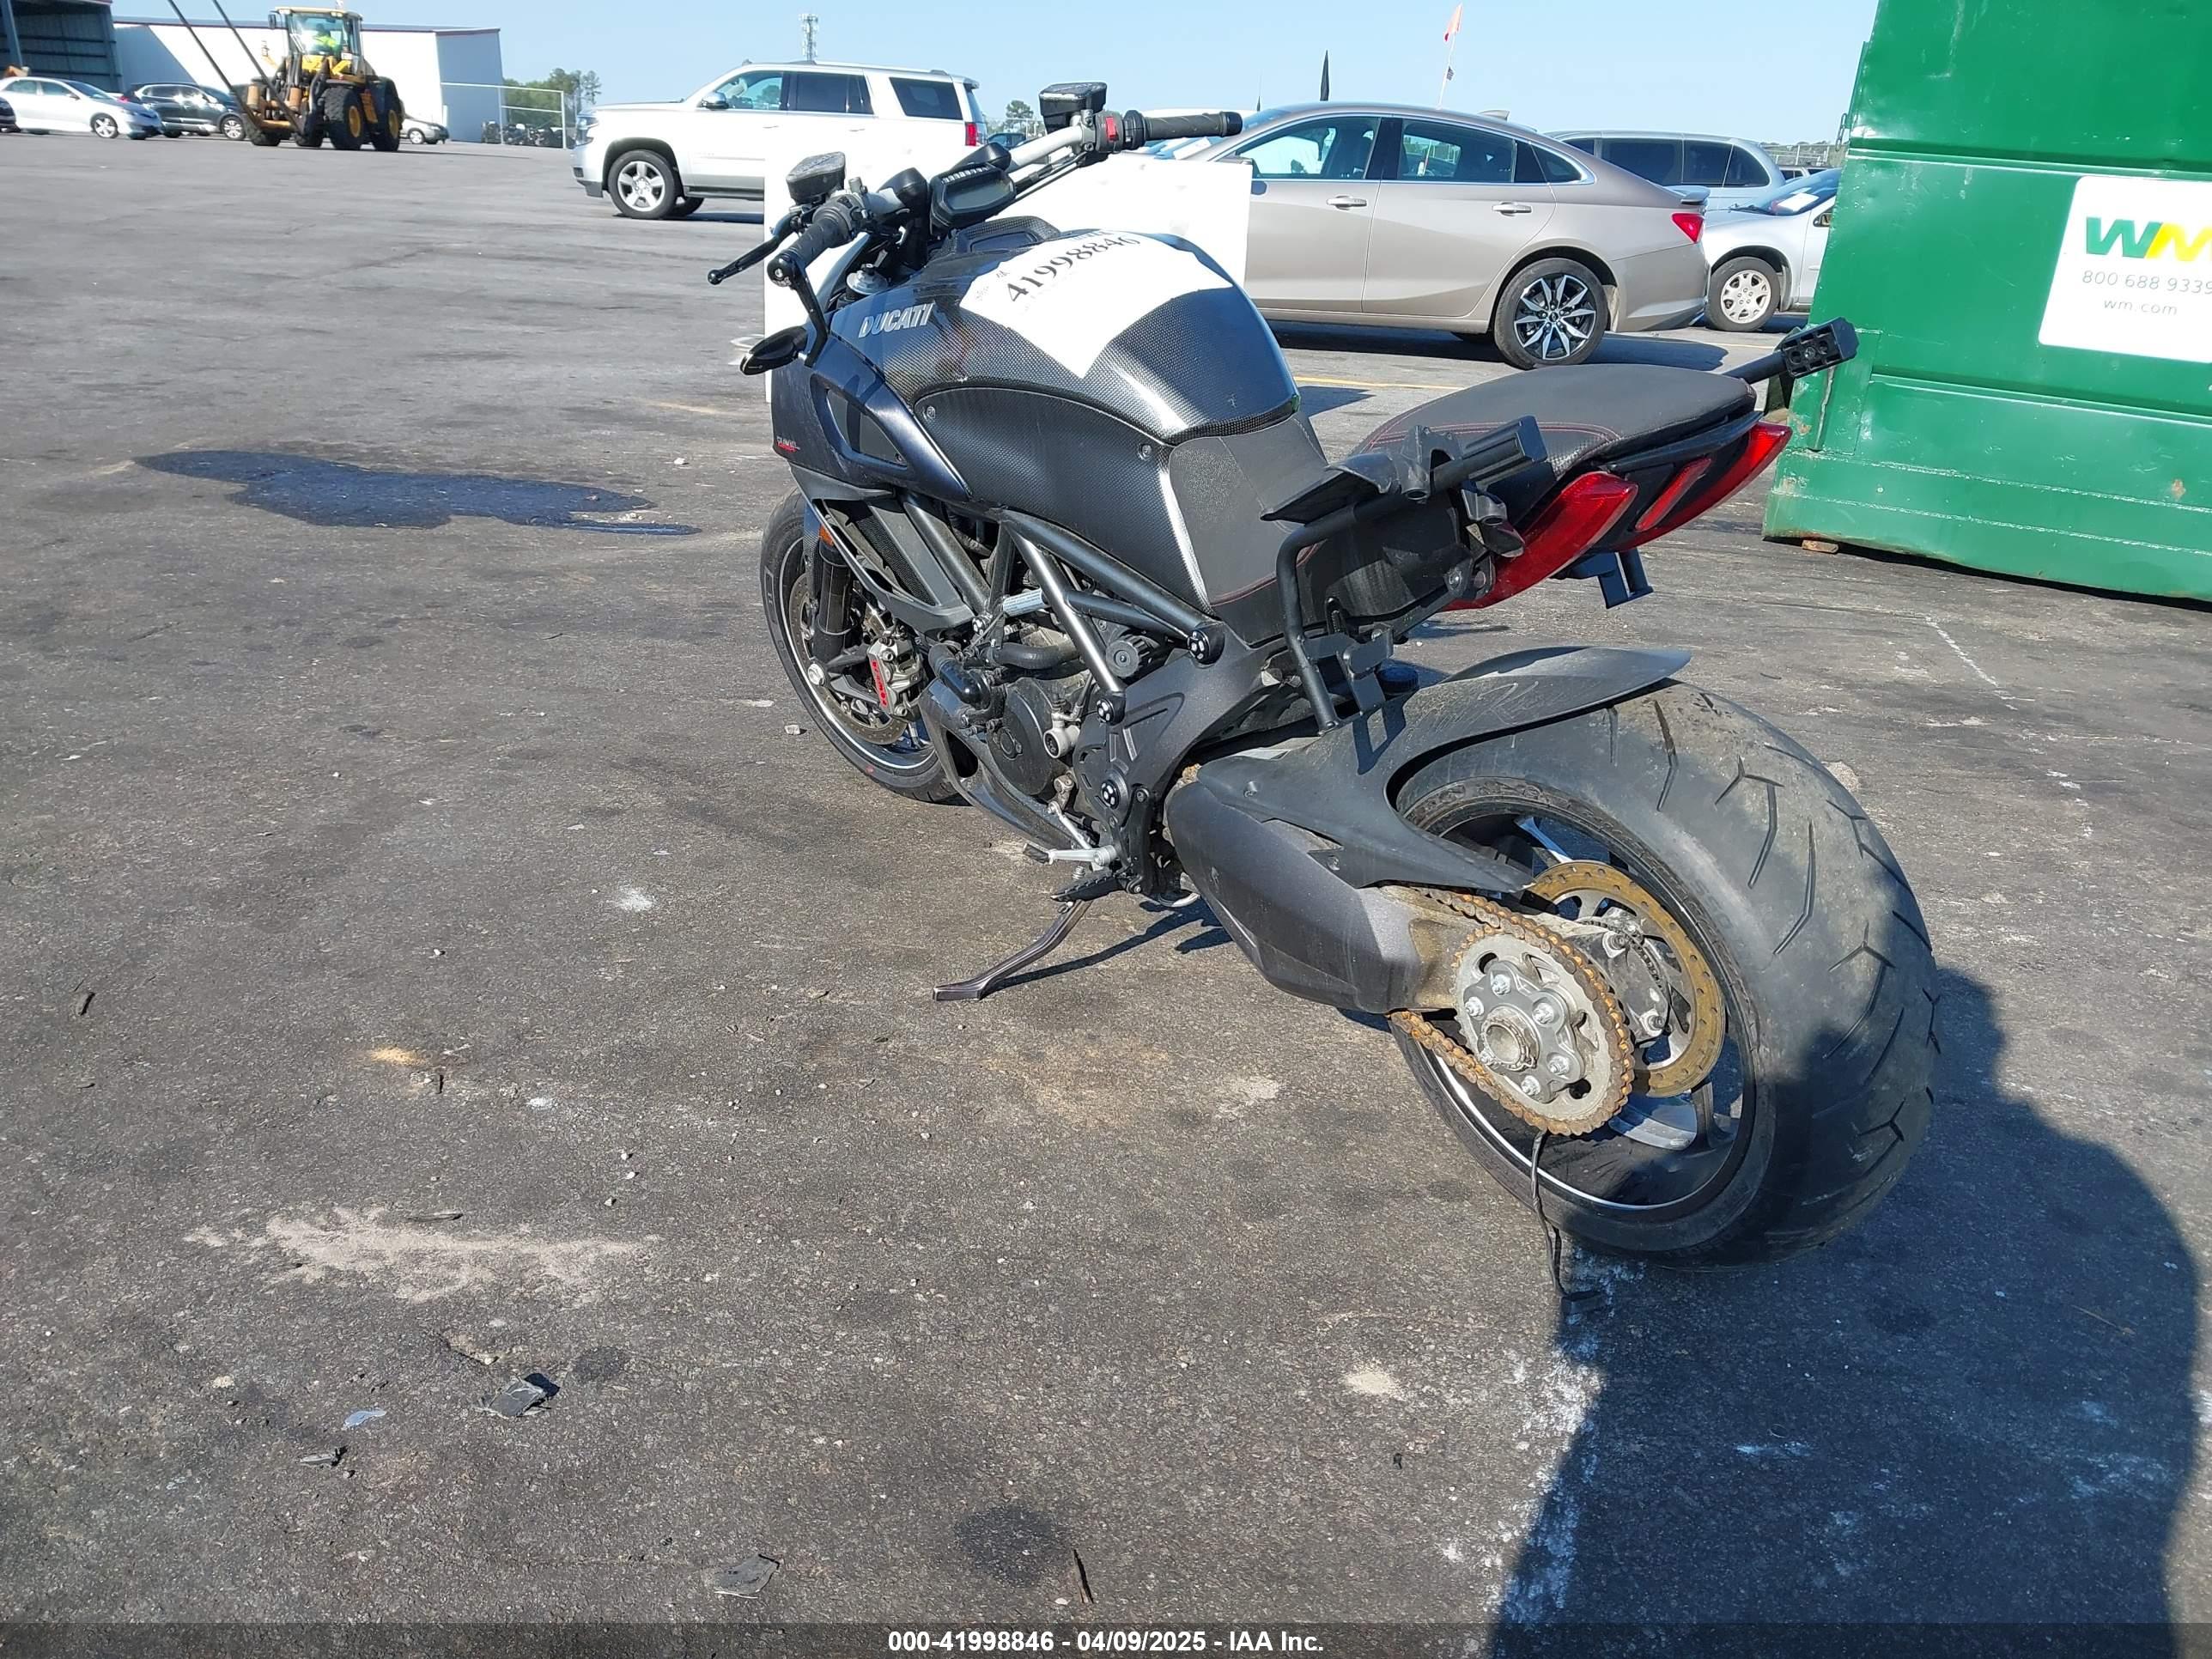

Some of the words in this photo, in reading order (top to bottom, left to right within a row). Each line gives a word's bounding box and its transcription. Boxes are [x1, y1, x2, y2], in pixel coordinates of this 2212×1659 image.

[2087, 216, 2212, 261] WM
[1007, 236, 1140, 301] 41998846
[2082, 270, 2118, 286] 800
[2125, 274, 2160, 290] 688
[859, 302, 934, 337] DUCATI
[2104, 300, 2178, 315] wm.com
